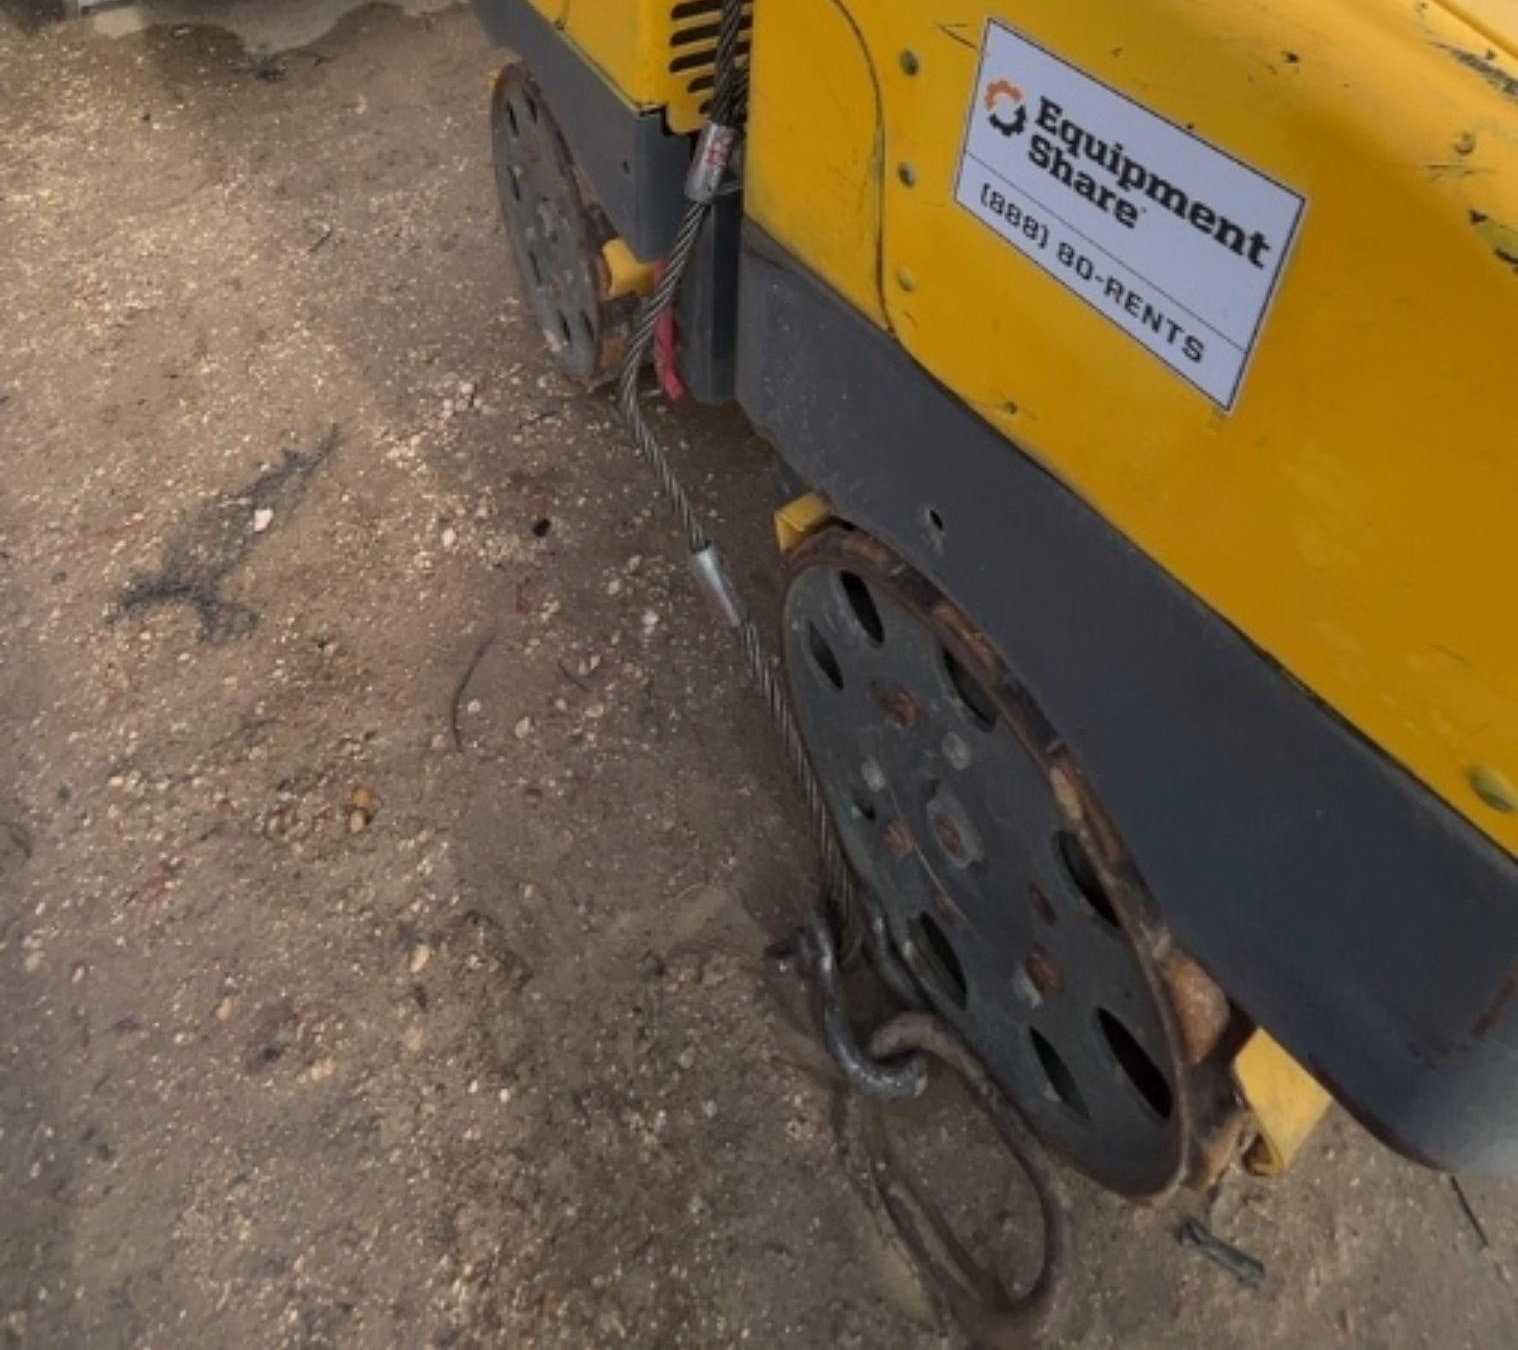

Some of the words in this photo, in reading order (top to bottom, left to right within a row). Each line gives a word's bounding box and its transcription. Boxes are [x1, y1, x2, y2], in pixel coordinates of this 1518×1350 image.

[1027, 134, 1141, 229] Share
[1033, 96, 1272, 270] Equipment
[979, 182, 1050, 250] (888)
[1057, 241, 1205, 364] 80-RENTS
